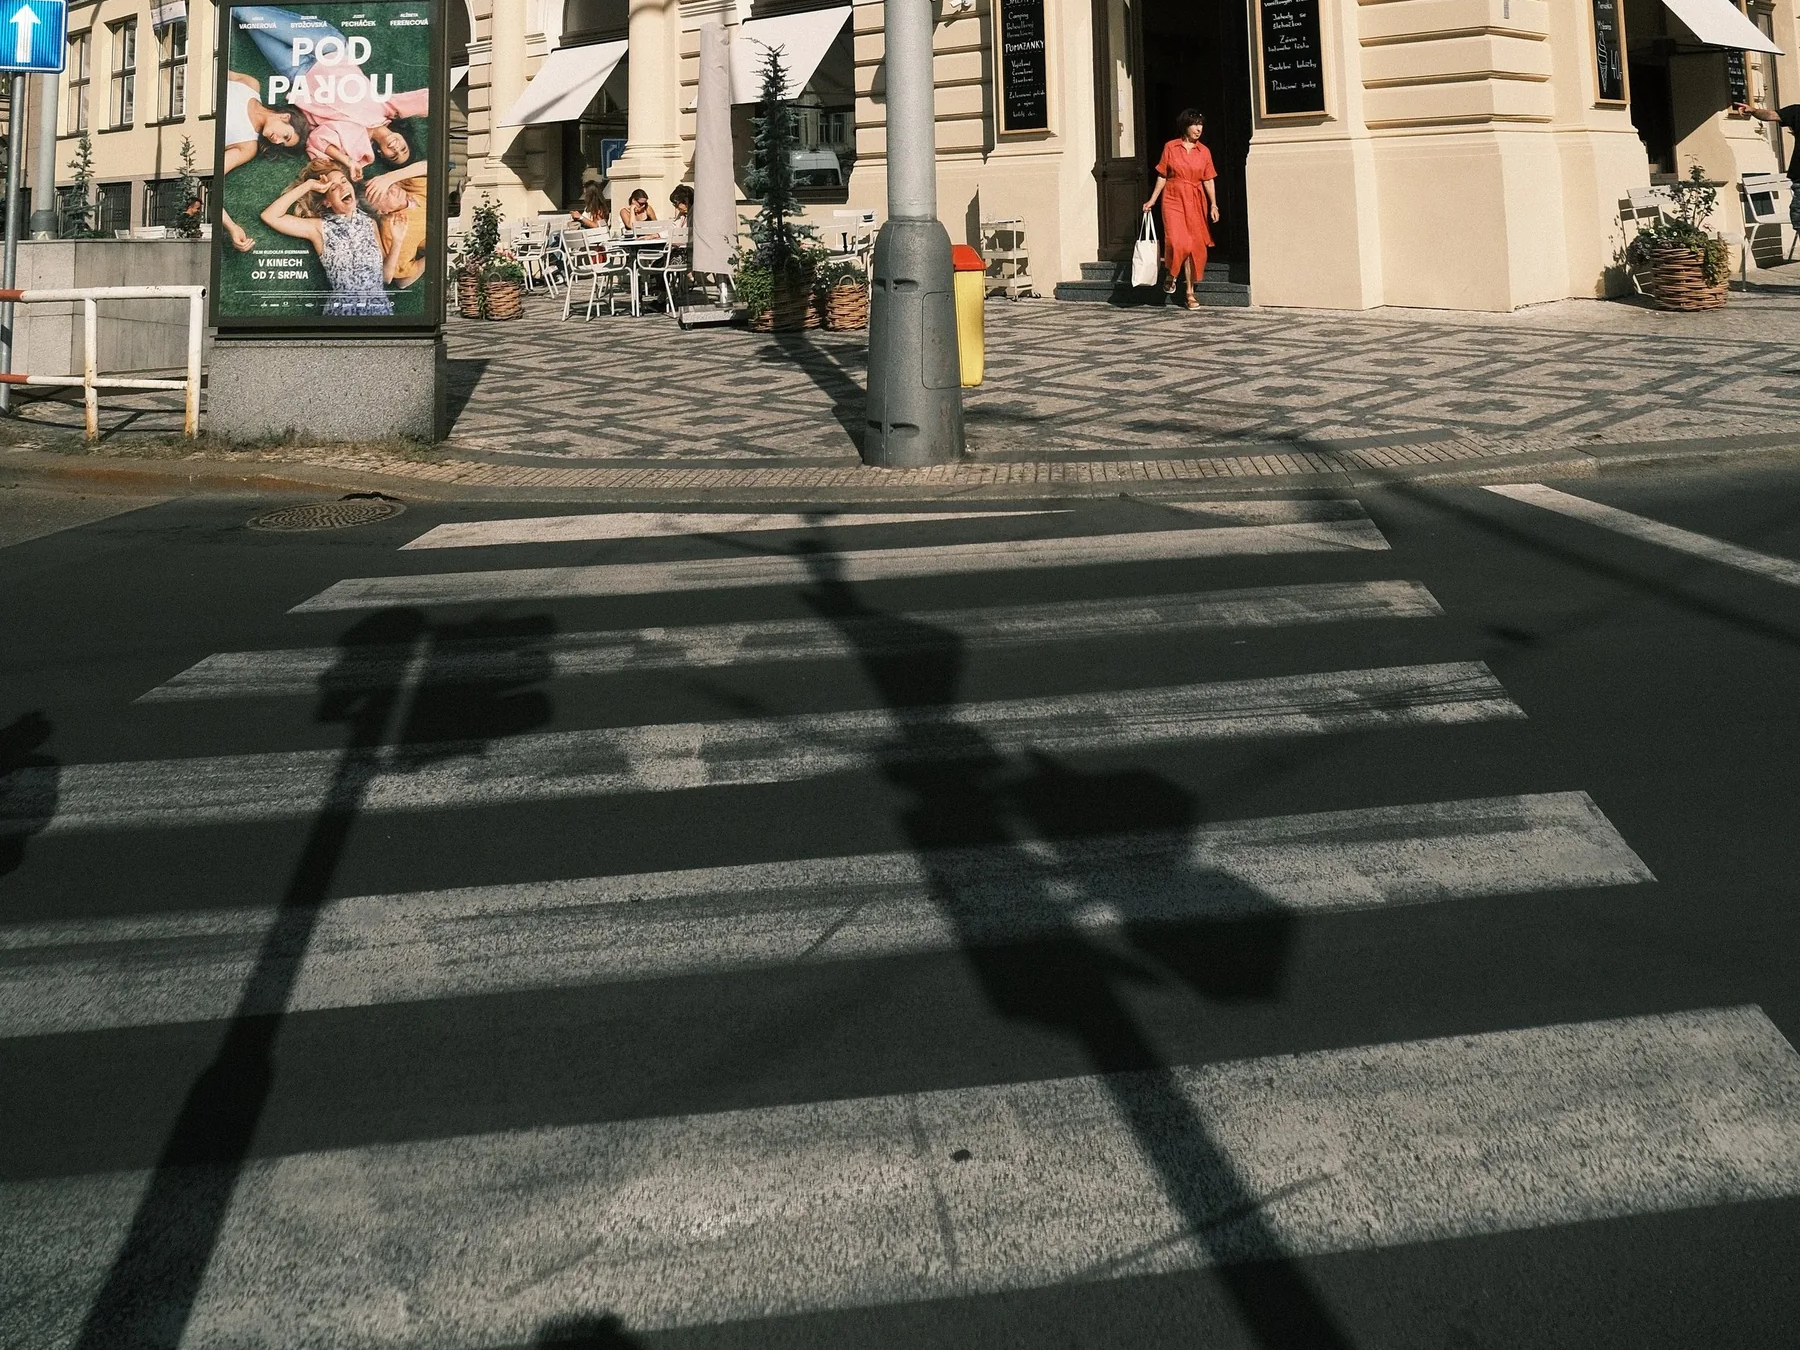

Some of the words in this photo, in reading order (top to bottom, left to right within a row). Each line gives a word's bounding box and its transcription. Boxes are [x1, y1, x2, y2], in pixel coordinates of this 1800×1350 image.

[1006, 38, 1044, 53] POMAZÁNKY
[292, 36, 371, 67] POD
[258, 259, 265, 267] V
[267, 259, 303, 267] KINECH
[252, 271, 266, 279] OD
[268, 271, 275, 279] 7.
[278, 271, 308, 279] SRPNA
